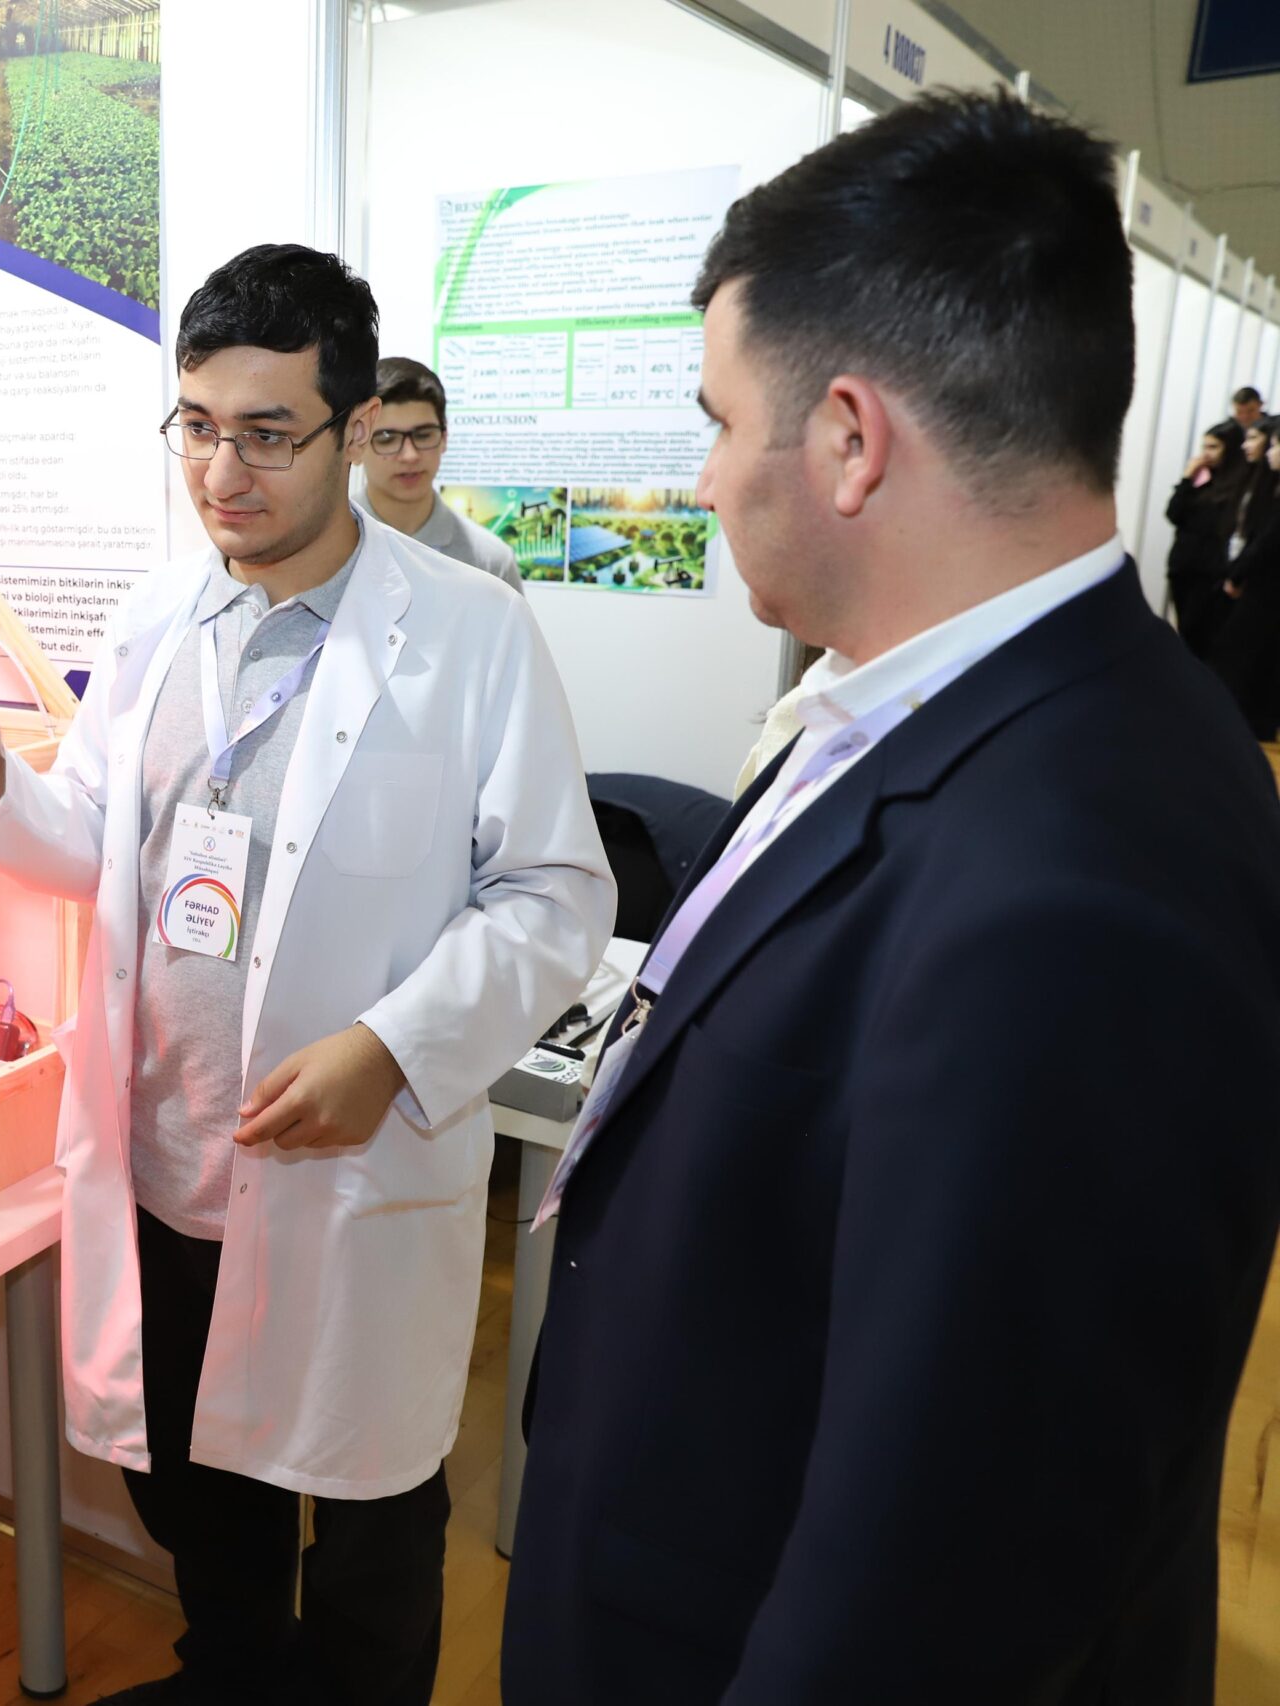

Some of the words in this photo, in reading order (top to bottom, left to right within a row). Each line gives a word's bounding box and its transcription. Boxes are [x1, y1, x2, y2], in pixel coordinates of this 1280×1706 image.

[453, 414, 538, 425] CONCLUSION
[59, 577, 104, 589] bitkilərin
[107, 578, 135, 591] inkiş
[12, 593, 23, 601] və
[25, 593, 55, 605] bioloji
[57, 594, 119, 607] ehtiyaclarını
[26, 625, 85, 638] istemimizin
[184, 900, 220, 916] FƏRHAD
[185, 913, 215, 928] ƏLİYEV
